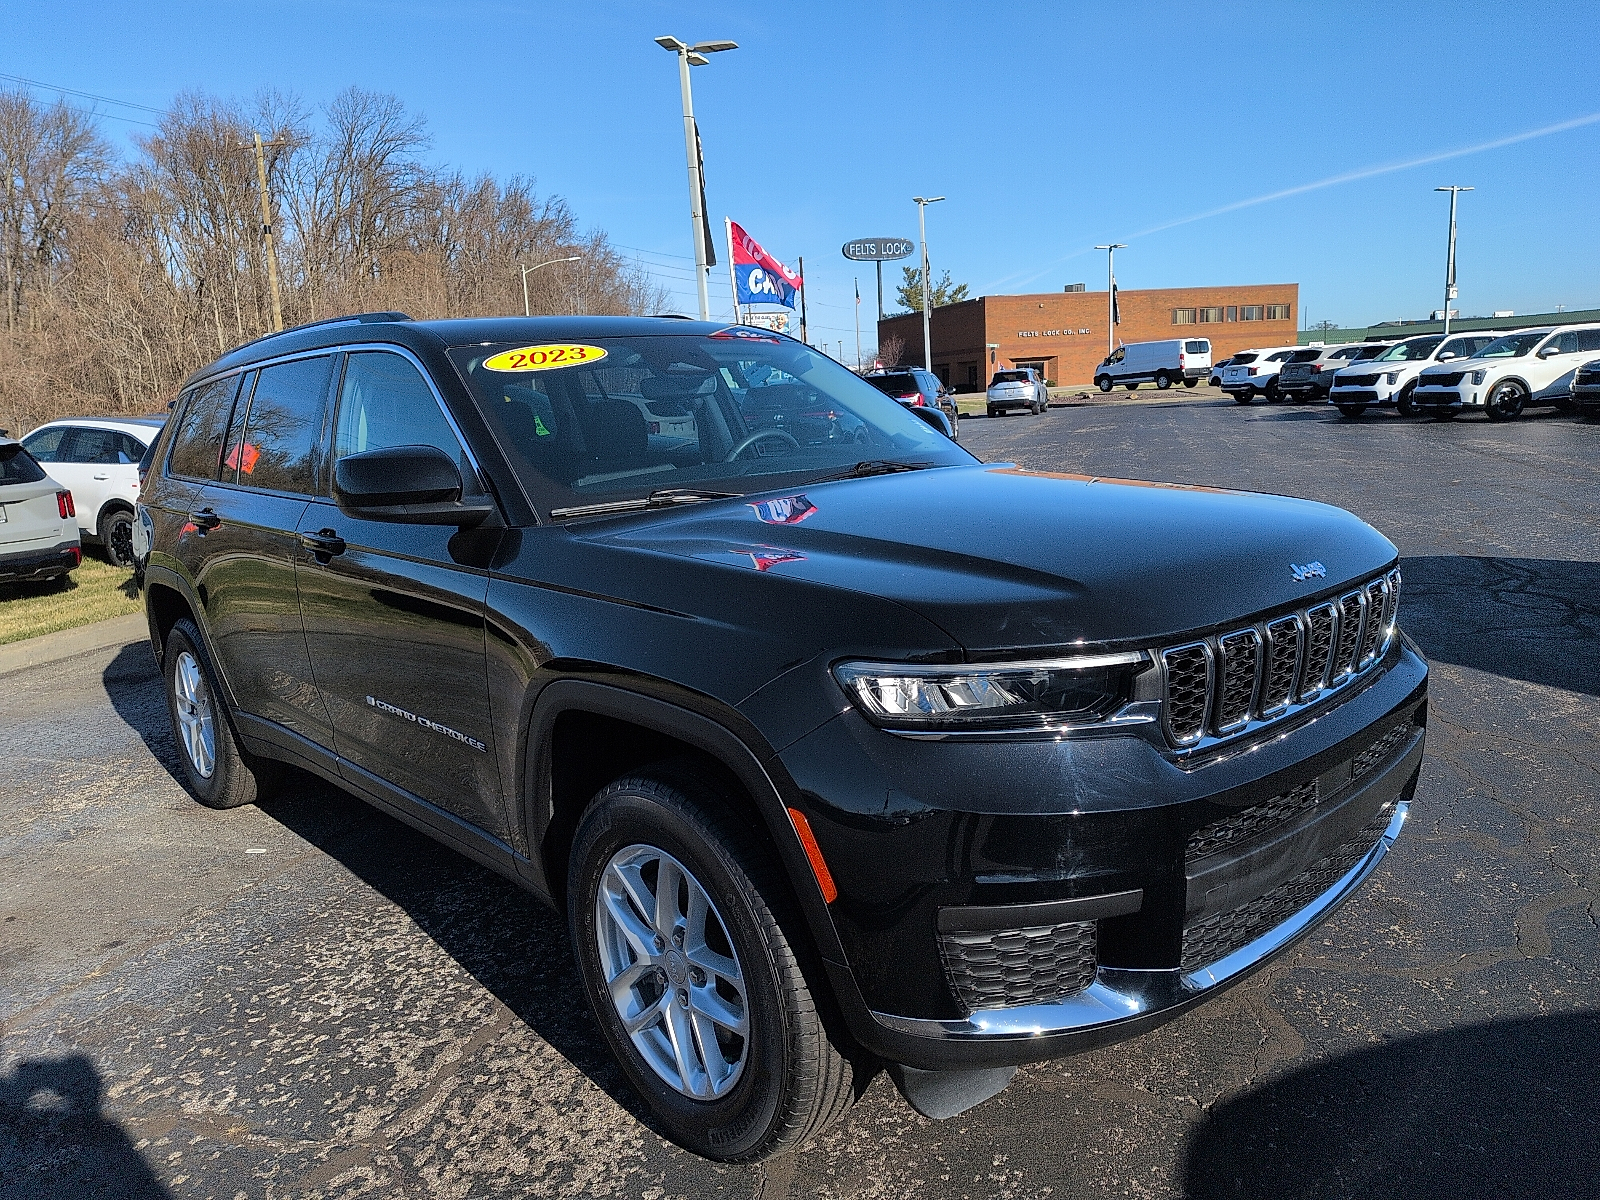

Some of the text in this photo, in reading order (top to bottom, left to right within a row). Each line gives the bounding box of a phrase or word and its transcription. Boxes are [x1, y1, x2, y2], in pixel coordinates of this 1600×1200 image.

[849, 243, 876, 255] FELTS
[881, 242, 907, 254] LOCK
[509, 347, 587, 369] 2023
[1290, 560, 1327, 582] Jeep
[375, 700, 487, 753] GRAND CHEROKEE
